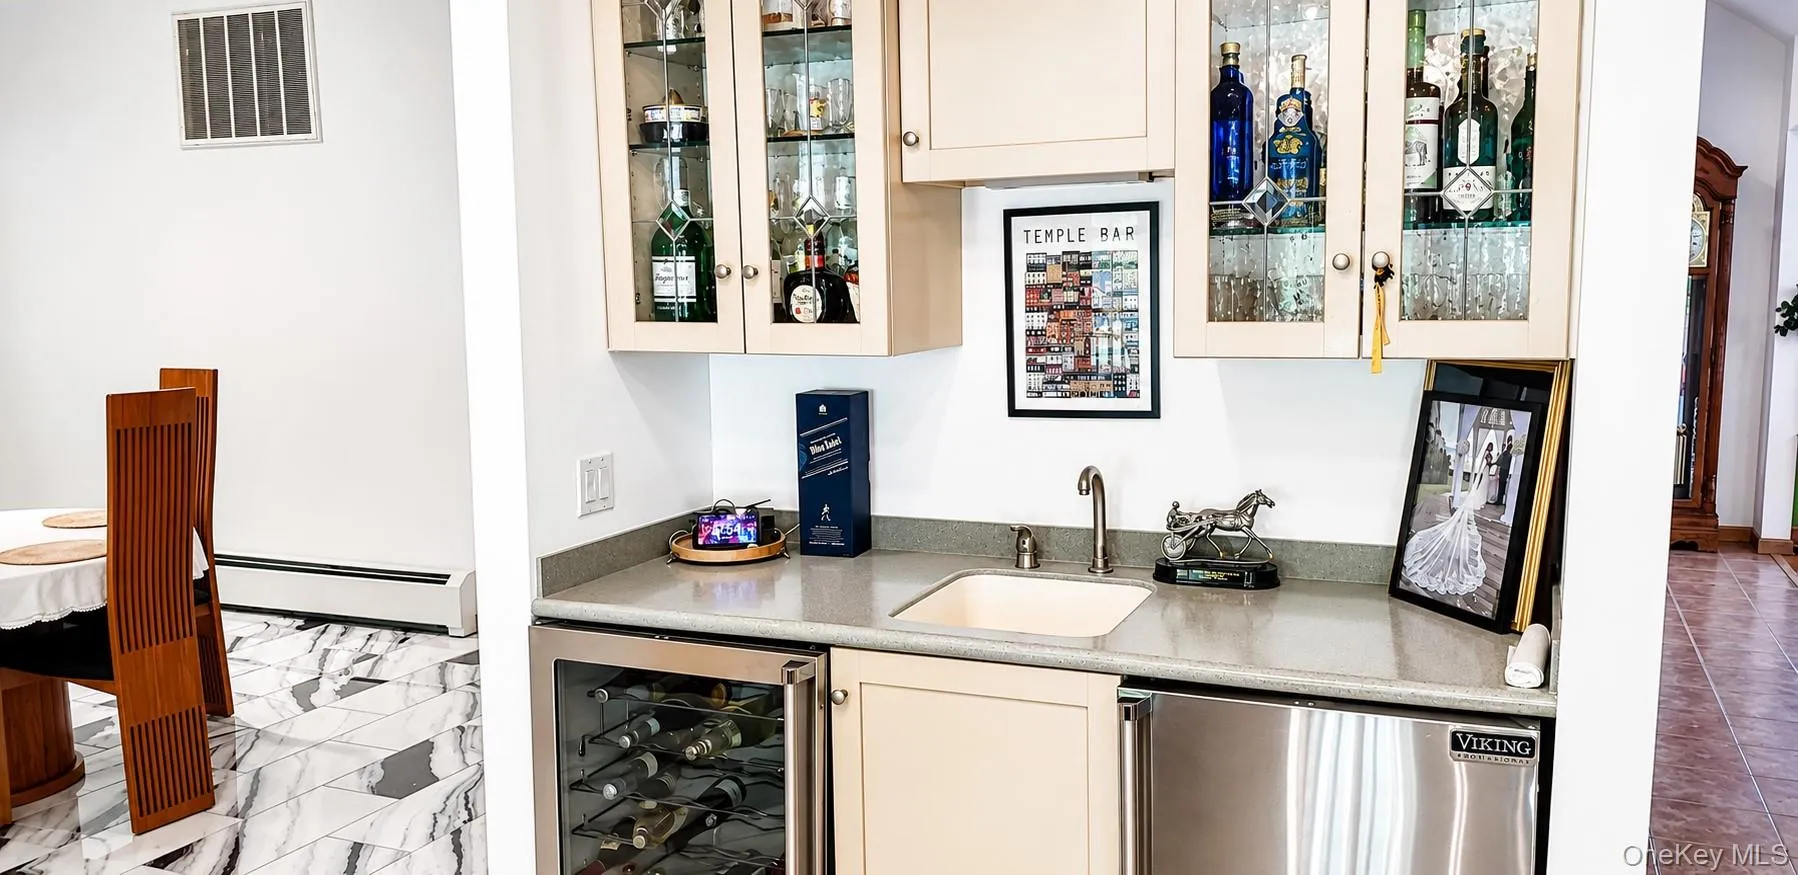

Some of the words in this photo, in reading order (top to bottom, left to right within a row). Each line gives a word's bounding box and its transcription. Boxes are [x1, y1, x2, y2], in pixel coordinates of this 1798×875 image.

[1023, 227, 1086, 244] TEMPLE
[1100, 226, 1135, 242] BAR
[1456, 733, 1532, 755] VIKING
